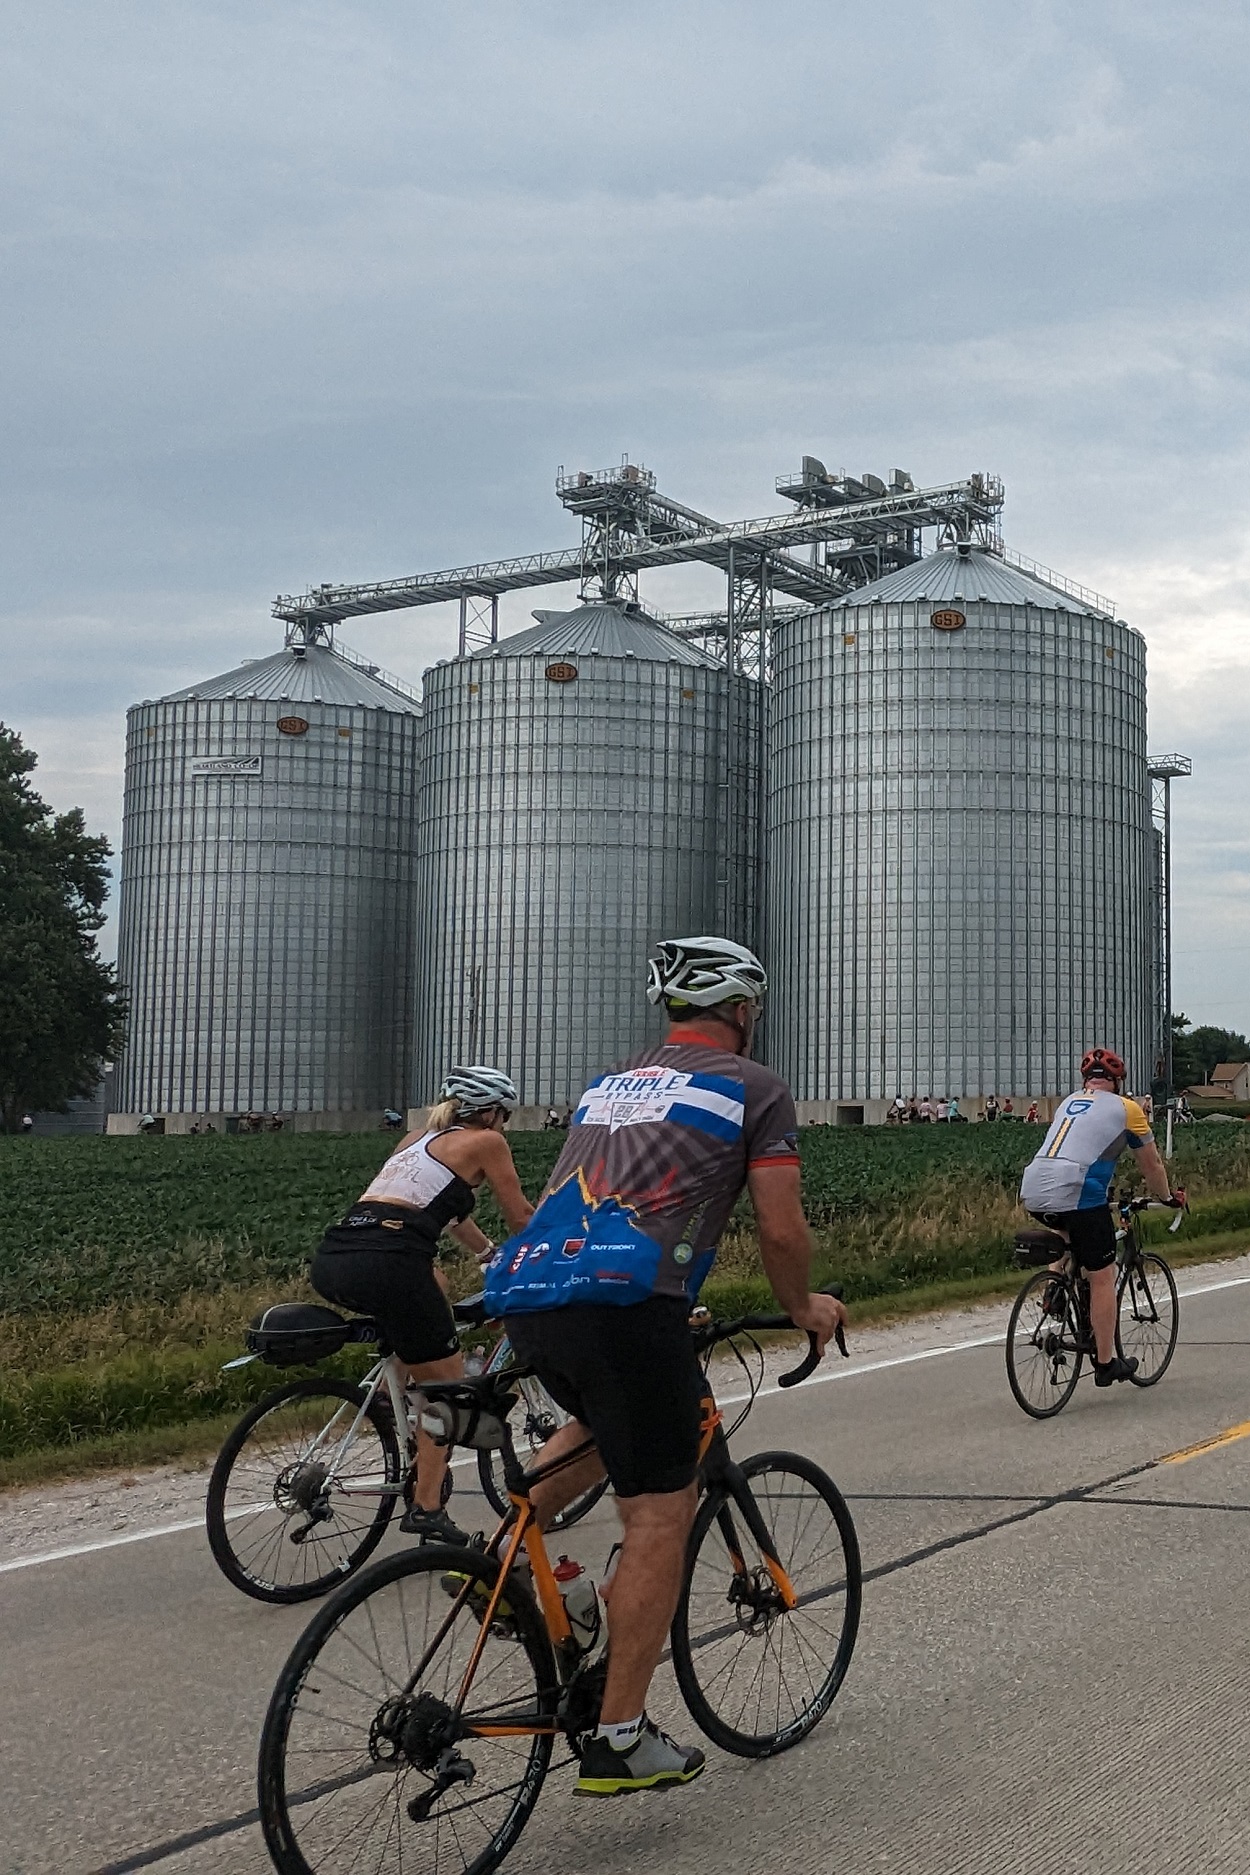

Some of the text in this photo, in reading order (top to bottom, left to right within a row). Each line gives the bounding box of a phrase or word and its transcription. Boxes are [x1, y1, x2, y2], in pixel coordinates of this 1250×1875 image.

[935, 613, 961, 626] GSI
[605, 1075, 686, 1092] TRIPLE
[605, 1092, 663, 1100] BYPASS
